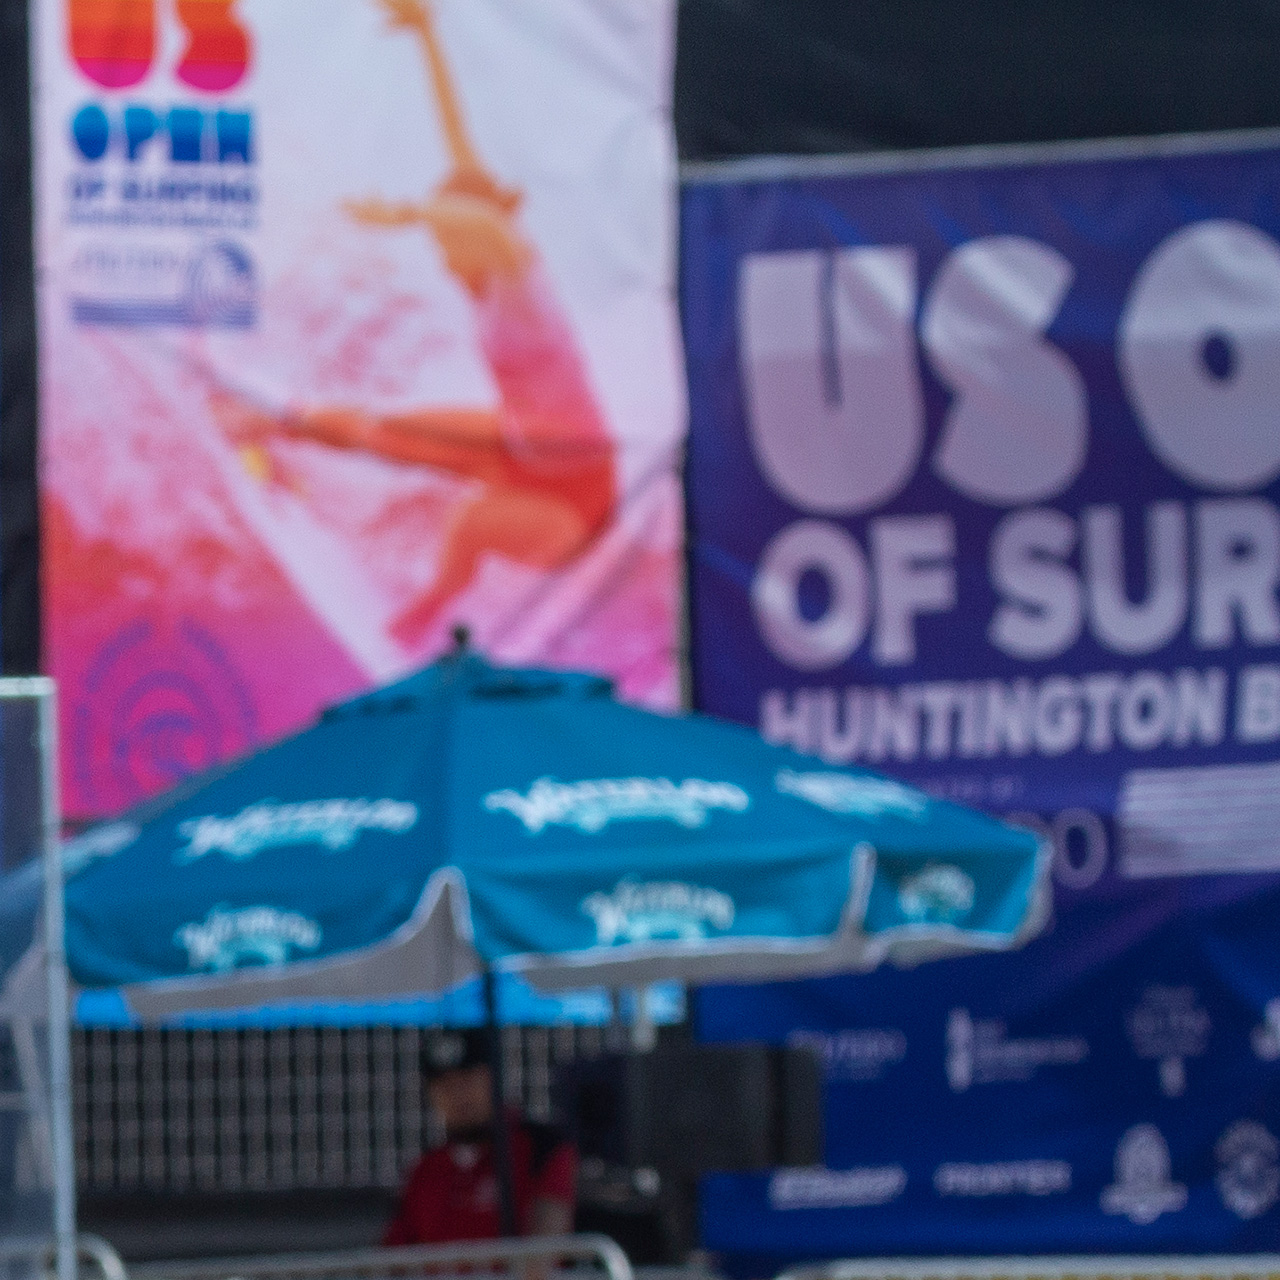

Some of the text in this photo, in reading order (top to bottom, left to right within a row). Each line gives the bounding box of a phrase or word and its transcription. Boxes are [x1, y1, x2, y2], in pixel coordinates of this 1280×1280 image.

[742, 233, 1092, 514] US
[753, 517, 958, 670] OF
[757, 666, 1228, 765] HUNTINGTON
